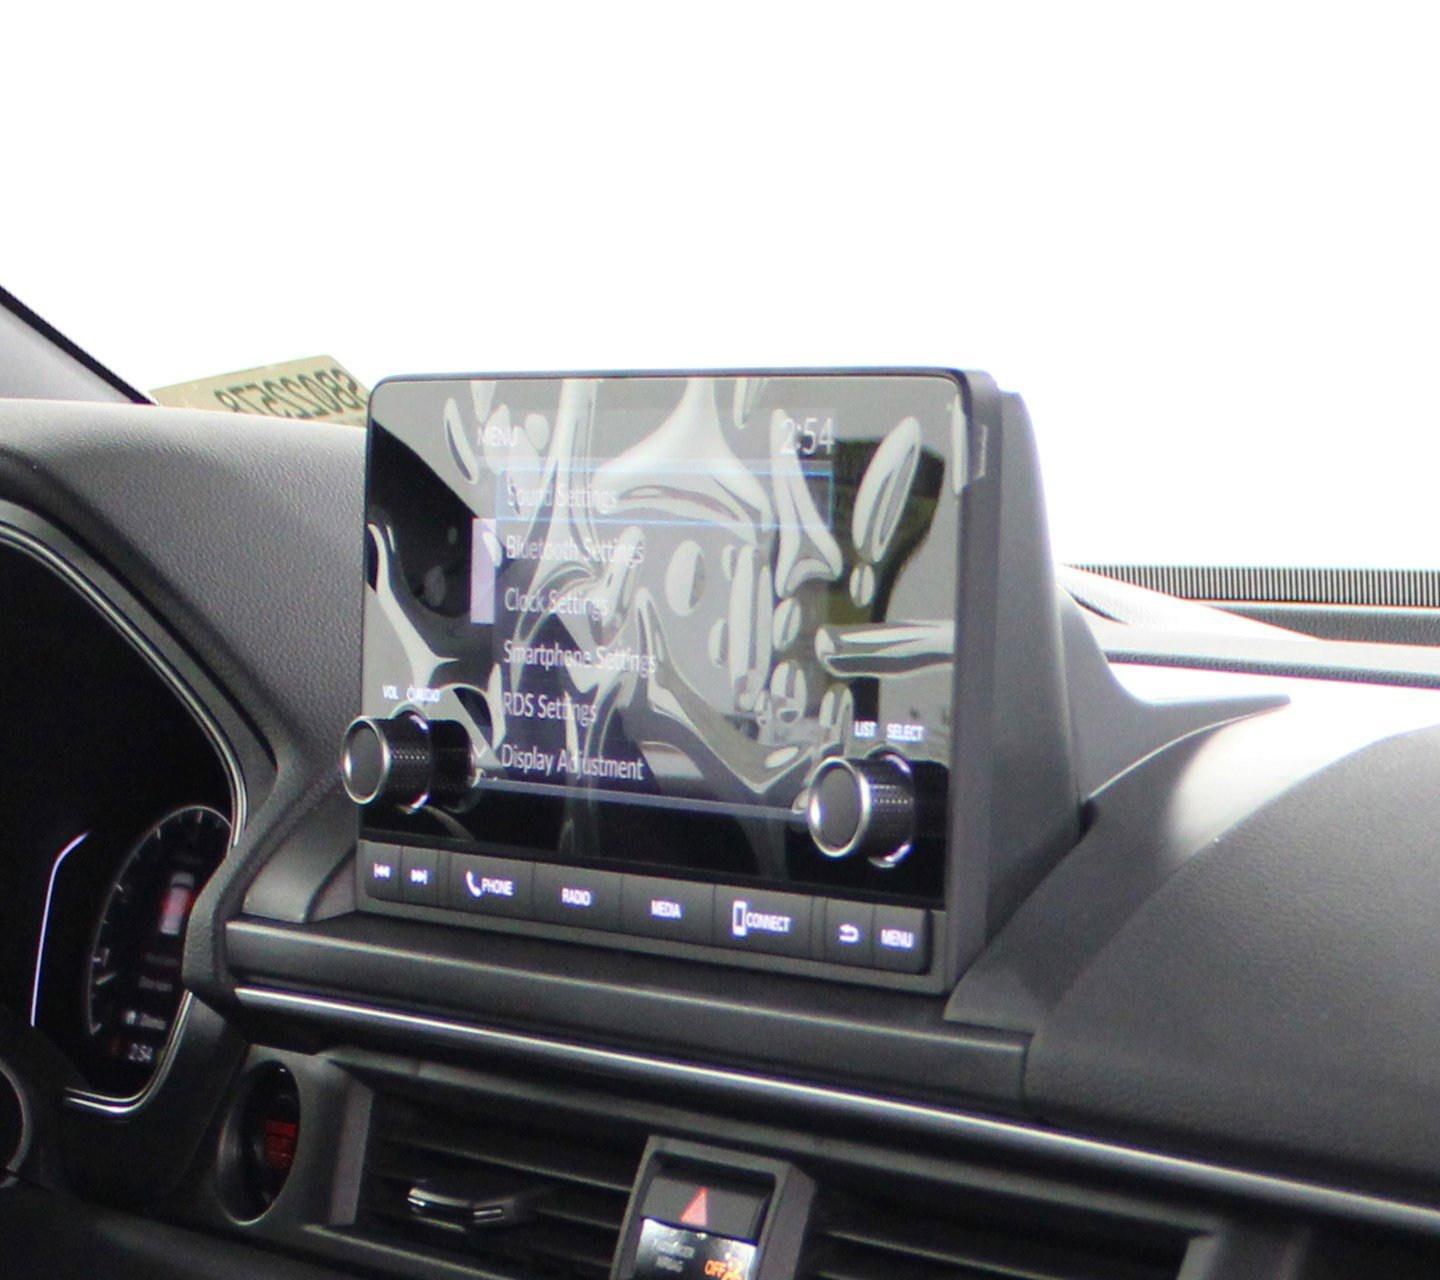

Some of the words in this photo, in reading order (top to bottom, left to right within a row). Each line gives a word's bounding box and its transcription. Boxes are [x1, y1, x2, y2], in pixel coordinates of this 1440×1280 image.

[477, 425, 518, 447] MENU
[780, 416, 834, 455] 2:54
[556, 483, 618, 514] Settings
[505, 535, 577, 560] Bluetooth
[583, 537, 644, 568] Settings
[504, 586, 544, 612] Clock
[548, 589, 609, 621] Settings
[503, 639, 593, 671] Smartphone
[596, 645, 657, 678] Settings
[382, 684, 399, 700] VOL
[503, 691, 534, 717] RDS
[537, 693, 597, 727] Settings
[853, 720, 877, 738] LIST
[886, 722, 925, 742] SELECT
[501, 743, 554, 776] Display
[556, 748, 645, 781] Adjustment
[480, 877, 514, 897] PHONE
[561, 886, 592, 907] RADIO
[650, 899, 682, 919] MEDIA
[746, 911, 791, 933] CONNECT
[880, 928, 915, 949] MENU
